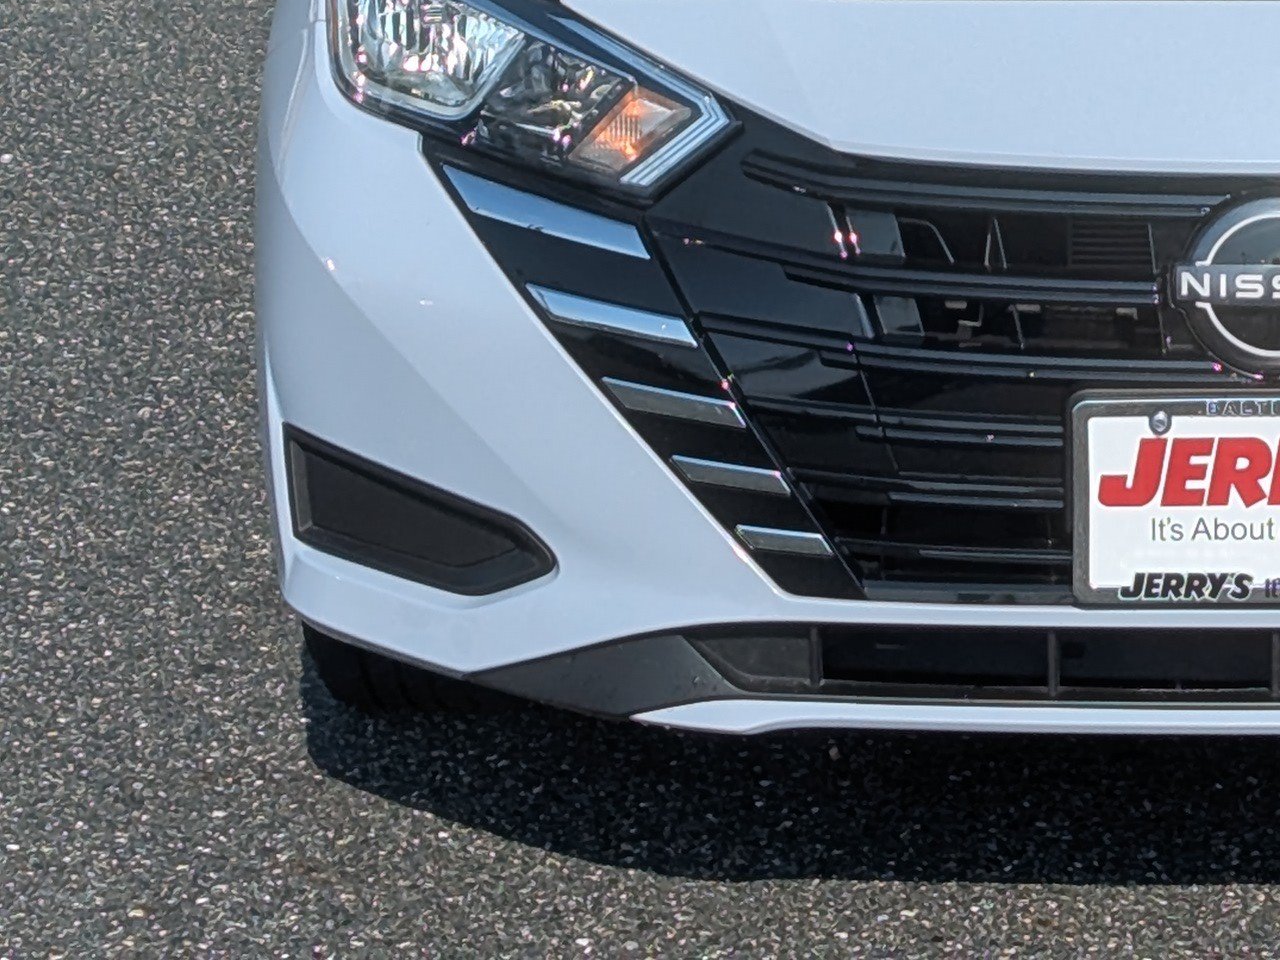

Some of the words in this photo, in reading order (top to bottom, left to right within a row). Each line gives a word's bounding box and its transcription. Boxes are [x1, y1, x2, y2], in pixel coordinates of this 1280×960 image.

[1151, 517, 1184, 541] It's
[1191, 517, 1275, 541] About
[1117, 571, 1254, 600] JERRY'S
